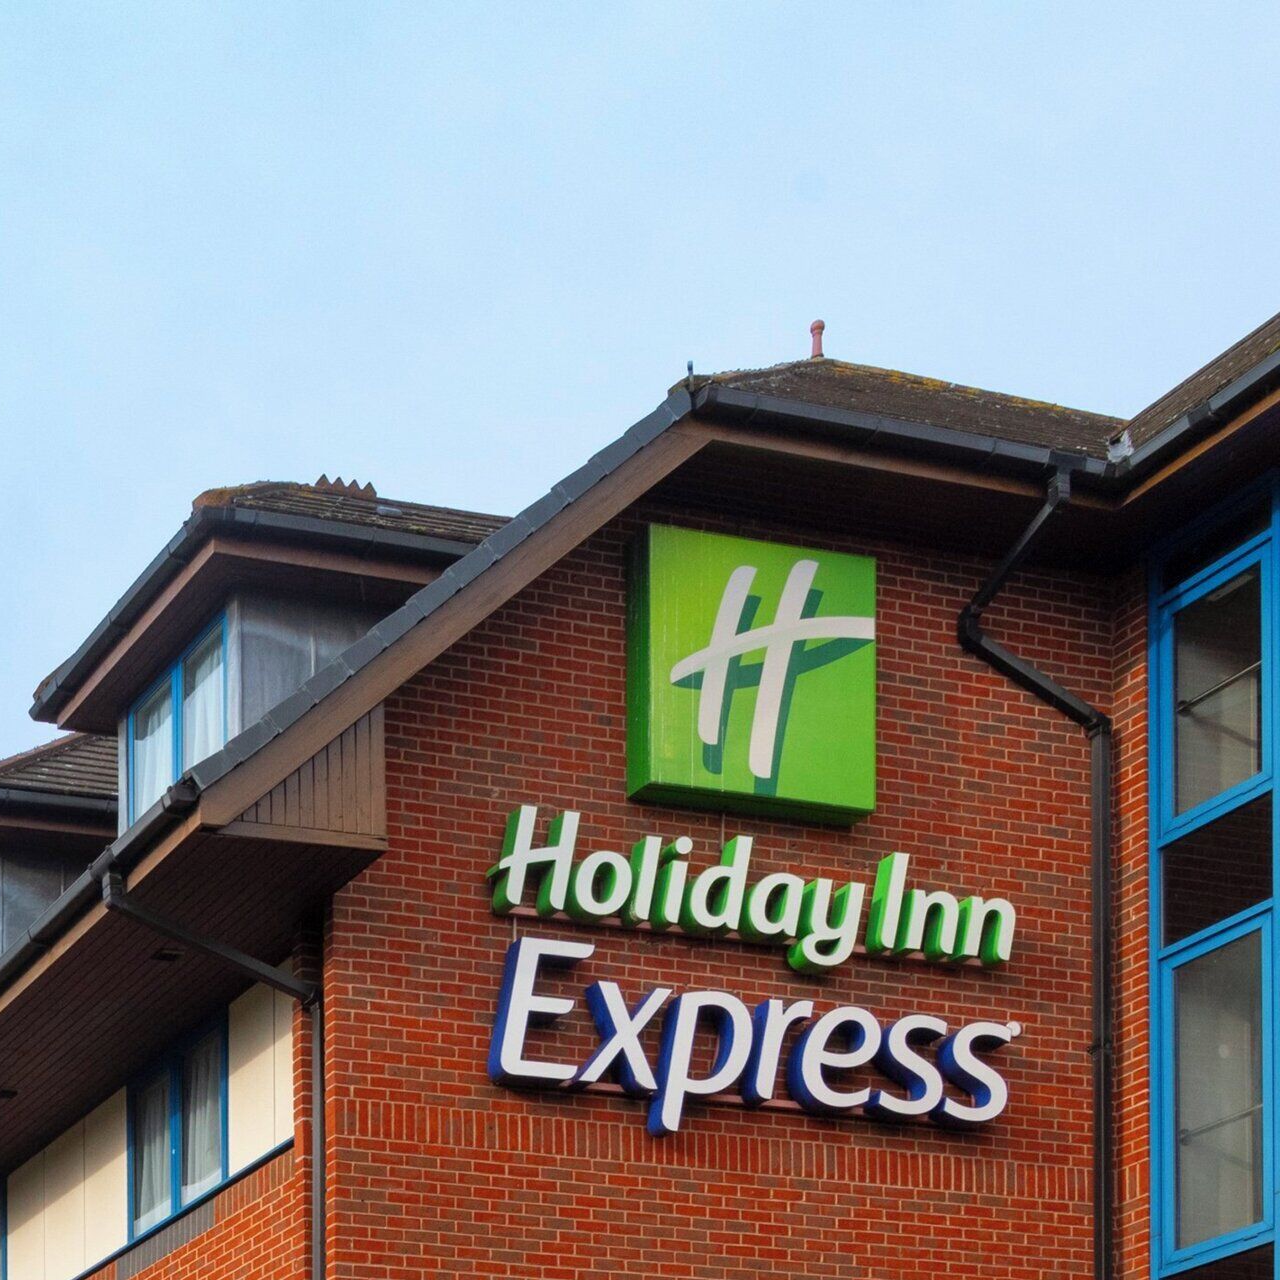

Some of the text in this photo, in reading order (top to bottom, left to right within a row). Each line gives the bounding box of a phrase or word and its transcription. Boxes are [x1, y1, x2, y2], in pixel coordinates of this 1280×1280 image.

[490, 805, 1017, 969] Holiday Inn
[492, 936, 1018, 1134] Express
